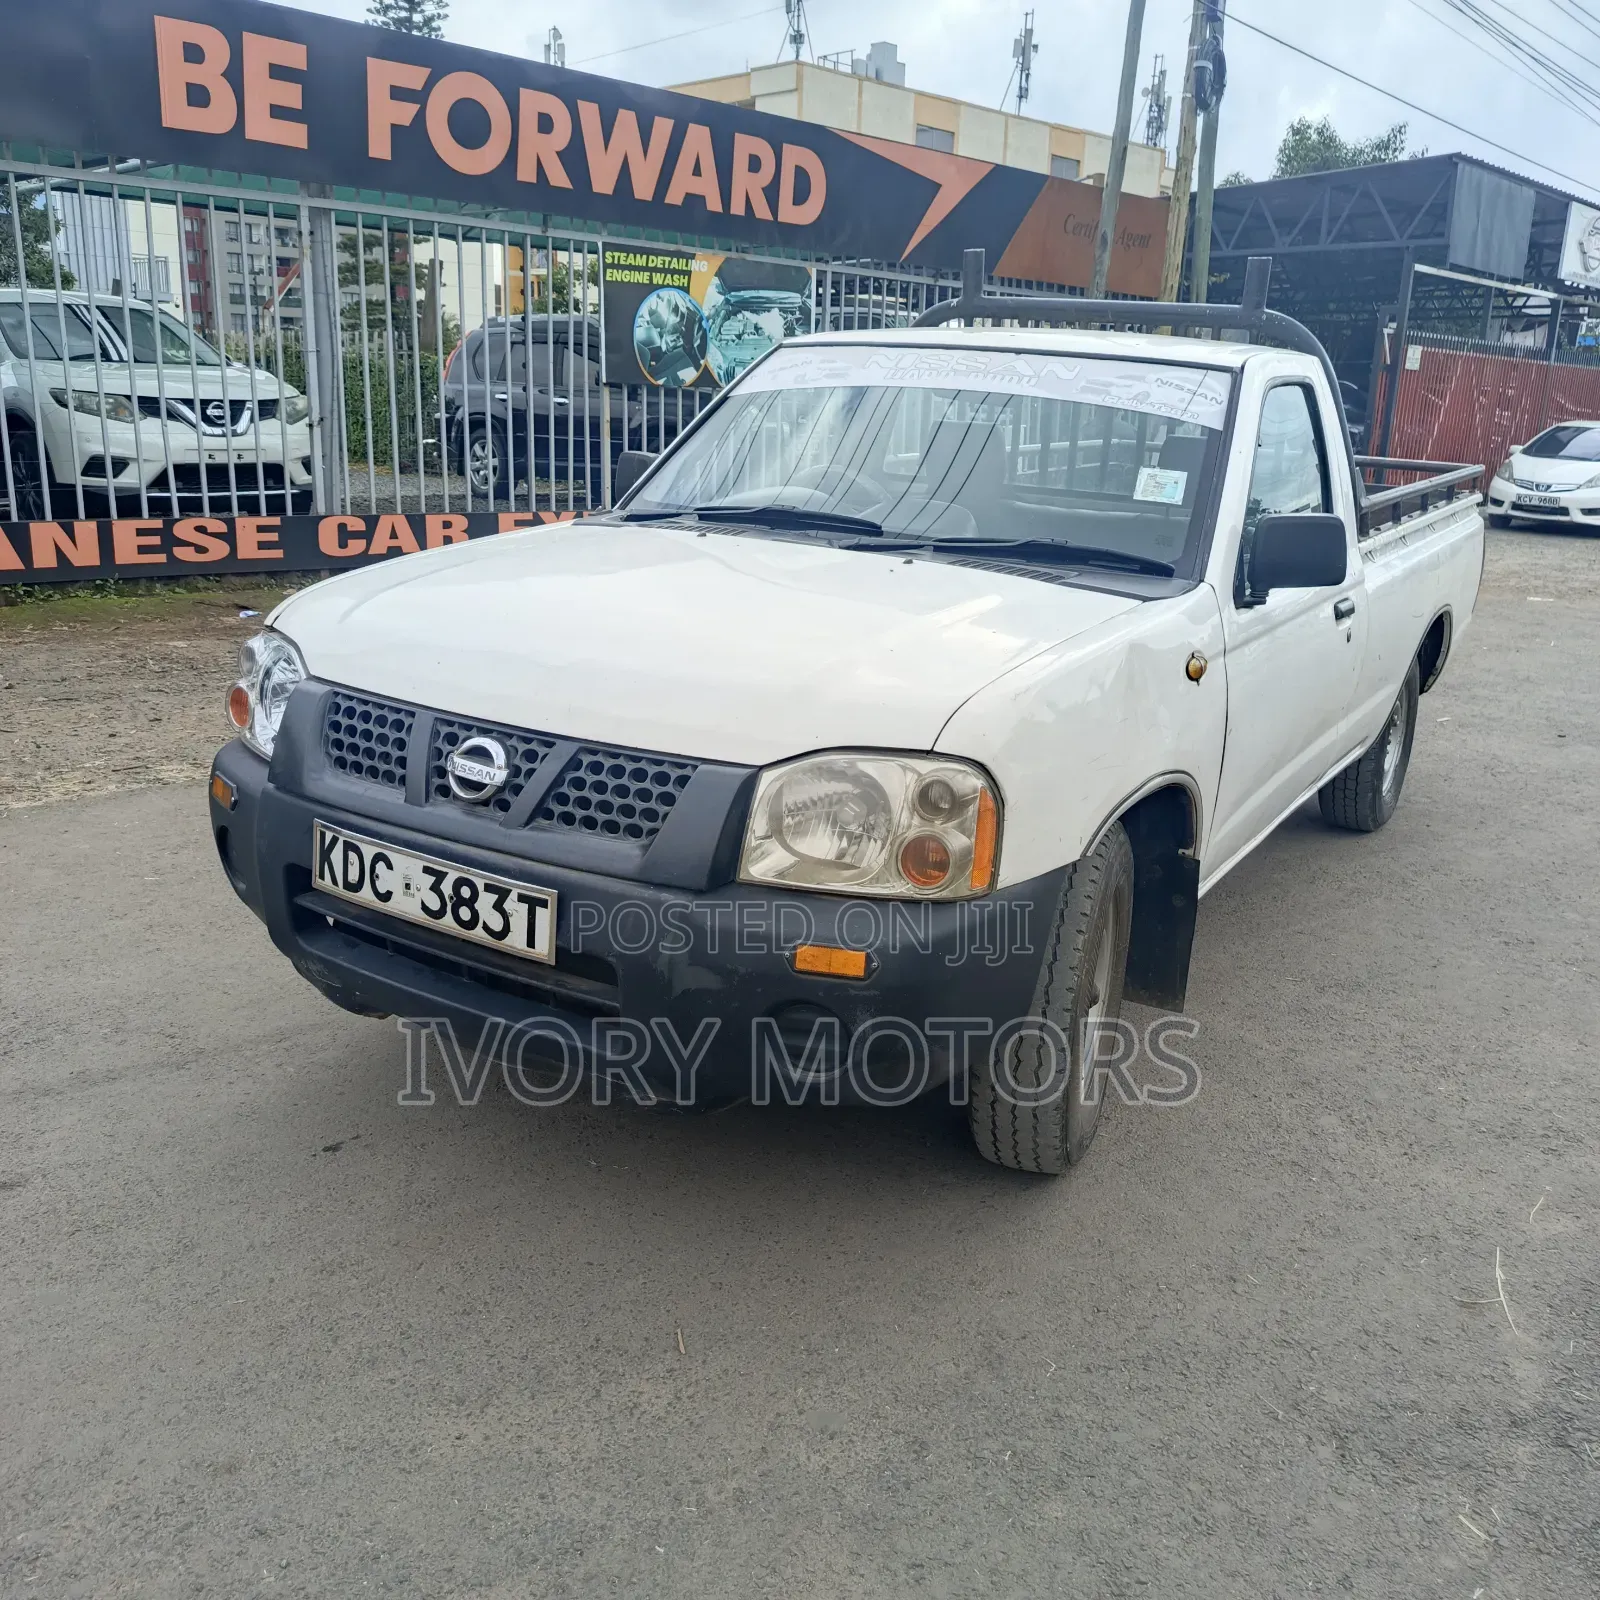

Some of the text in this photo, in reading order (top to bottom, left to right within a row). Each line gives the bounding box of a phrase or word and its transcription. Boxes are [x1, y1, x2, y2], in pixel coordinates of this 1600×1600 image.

[154, 15, 827, 225] BE FORWARD
[1063, 213, 1152, 252] Certif Agent
[605, 251, 708, 272] STEAM DETAILING
[606, 268, 689, 287] ENGINE WASH
[864, 353, 1083, 380] NISSAN
[1154, 377, 1224, 406] NISSAN
[1517, 495, 1533, 503] KCV
[318, 513, 469, 557] CAR
[449, 759, 496, 781] NISSAN
[319, 830, 549, 949] KDC 383T
